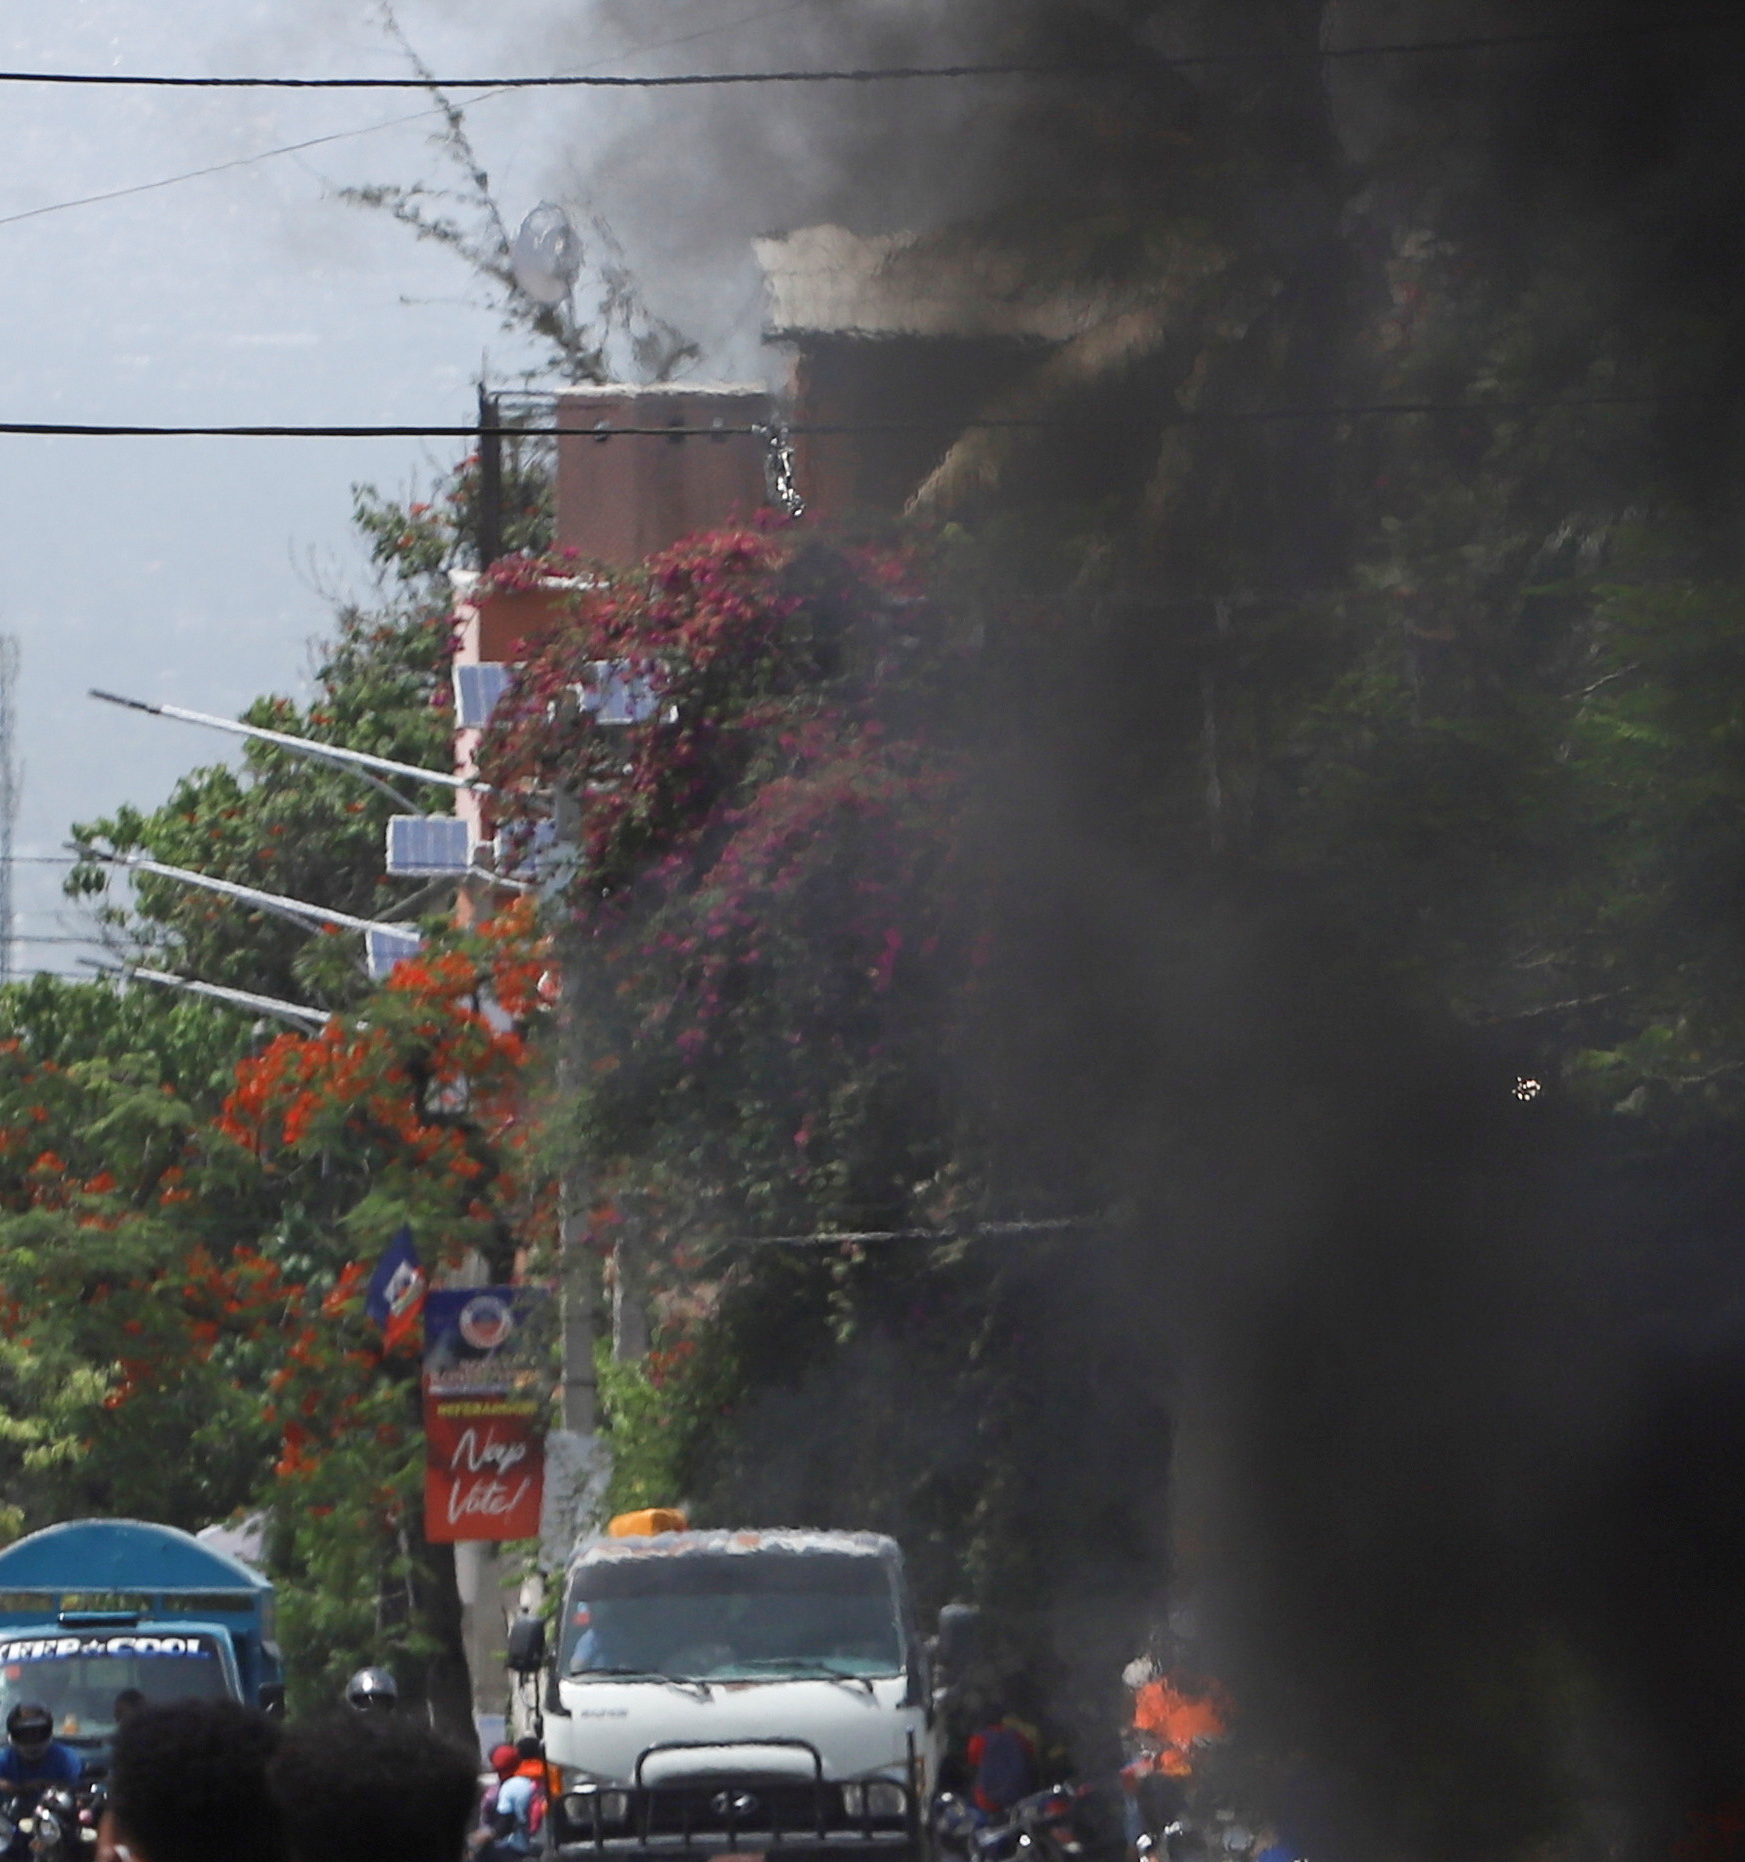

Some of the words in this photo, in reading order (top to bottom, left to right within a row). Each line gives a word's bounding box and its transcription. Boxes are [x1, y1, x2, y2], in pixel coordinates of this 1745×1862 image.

[451, 1425, 526, 1475] Nap
[447, 1476, 532, 1525] Vote!
[107, 1637, 210, 1658] COOL
